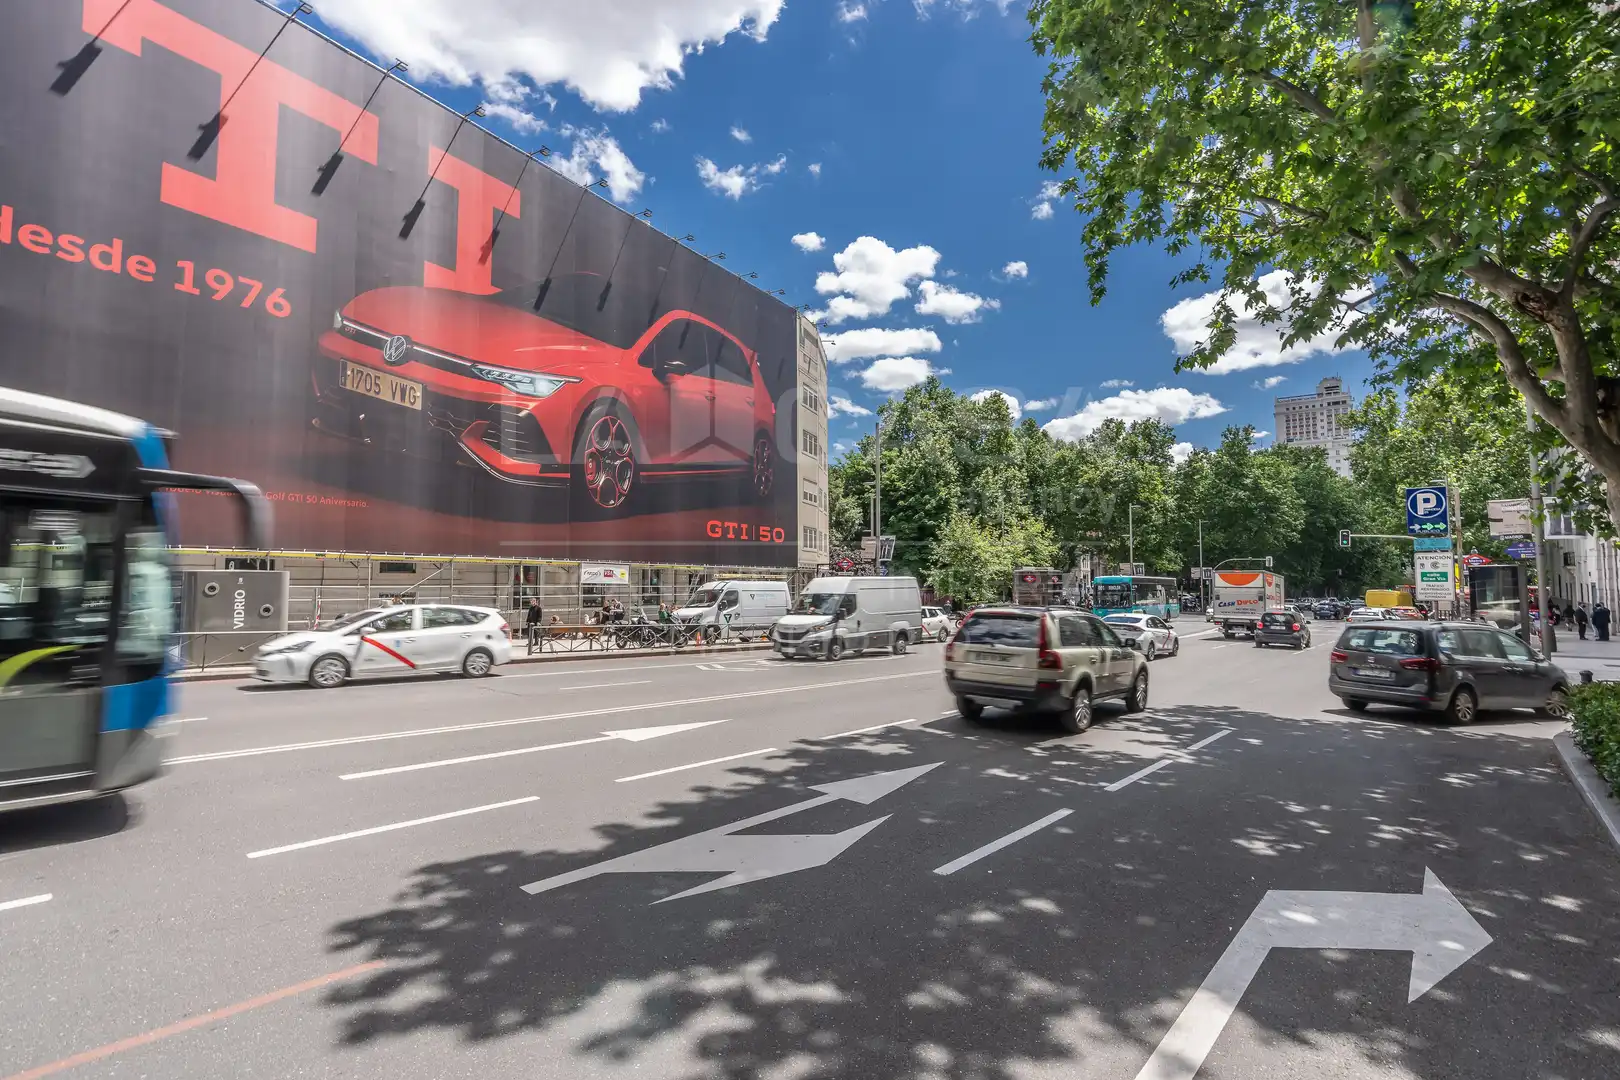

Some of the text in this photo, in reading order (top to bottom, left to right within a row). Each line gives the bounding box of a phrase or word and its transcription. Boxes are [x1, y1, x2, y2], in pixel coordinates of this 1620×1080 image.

[173, 260, 292, 318] 1976
[350, 367, 417, 406] 1705 VWG
[265, 491, 370, 509] Golf GTI 50 Aniversario.
[706, 520, 785, 544] GTI 50
[233, 589, 246, 630] VIDRIO
